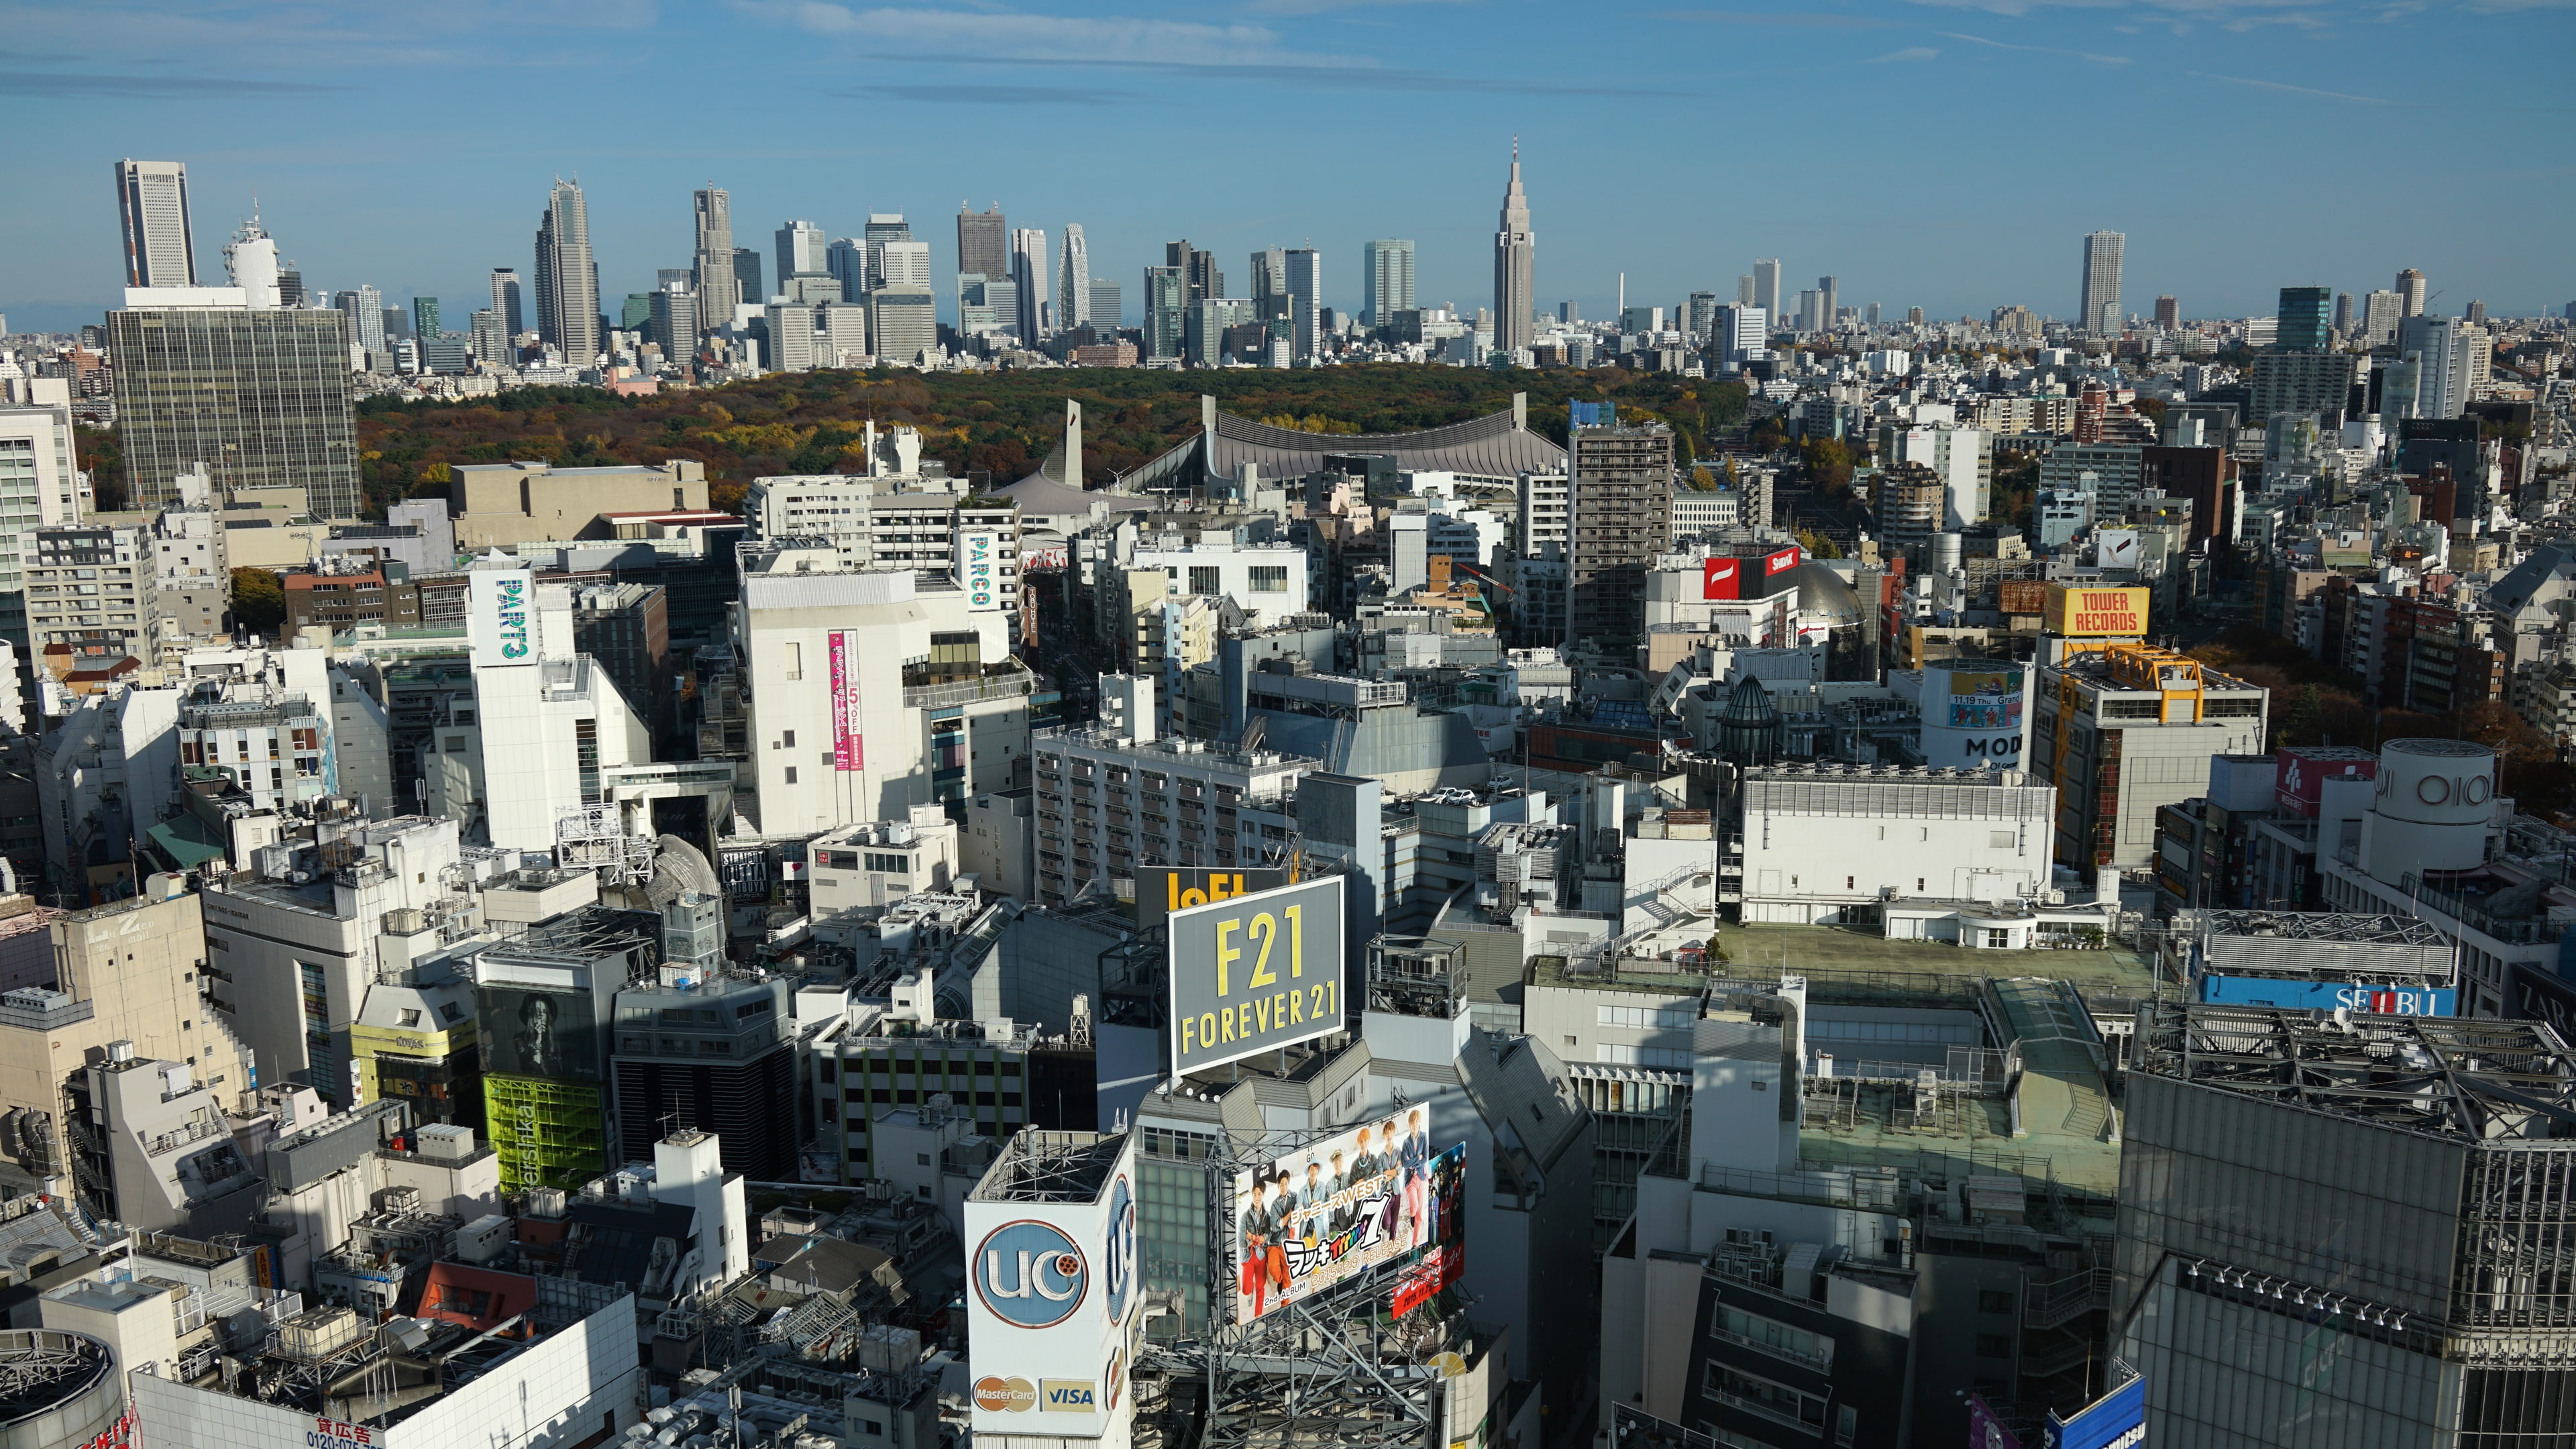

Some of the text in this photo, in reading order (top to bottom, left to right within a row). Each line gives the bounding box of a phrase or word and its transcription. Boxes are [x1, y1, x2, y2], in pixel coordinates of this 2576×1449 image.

[969, 537, 991, 605] PARCO
[1772, 552, 1793, 571] SHIDAX
[2082, 592, 2129, 611] TOWER
[496, 580, 528, 659] PART3
[2076, 612, 2137, 631] RECORDS
[1954, 696, 1976, 704] 11.19
[1998, 694, 2019, 704] Grand
[1966, 733, 2023, 757] MODI
[722, 851, 763, 865] STRAIGHT
[724, 863, 765, 883] OUTTA
[726, 881, 765, 893] SHIBUYA
[128, 930, 149, 944] mall
[1216, 904, 1302, 998] F21
[2336, 988, 2436, 1016] SEIBU
[2519, 981, 2576, 1036] ZAR
[1181, 980, 1335, 1055] FOREVER 21
[1291, 1176, 1383, 1226] ジャニーズWEST
[1311, 1256, 1360, 1289] 2015.12.9
[1362, 1234, 1407, 1265] RELEASE
[1265, 1282, 1307, 1307] 2nd ALBUM
[975, 1387, 1035, 1402] MasterCard
[1049, 1388, 1094, 1405] VISA
